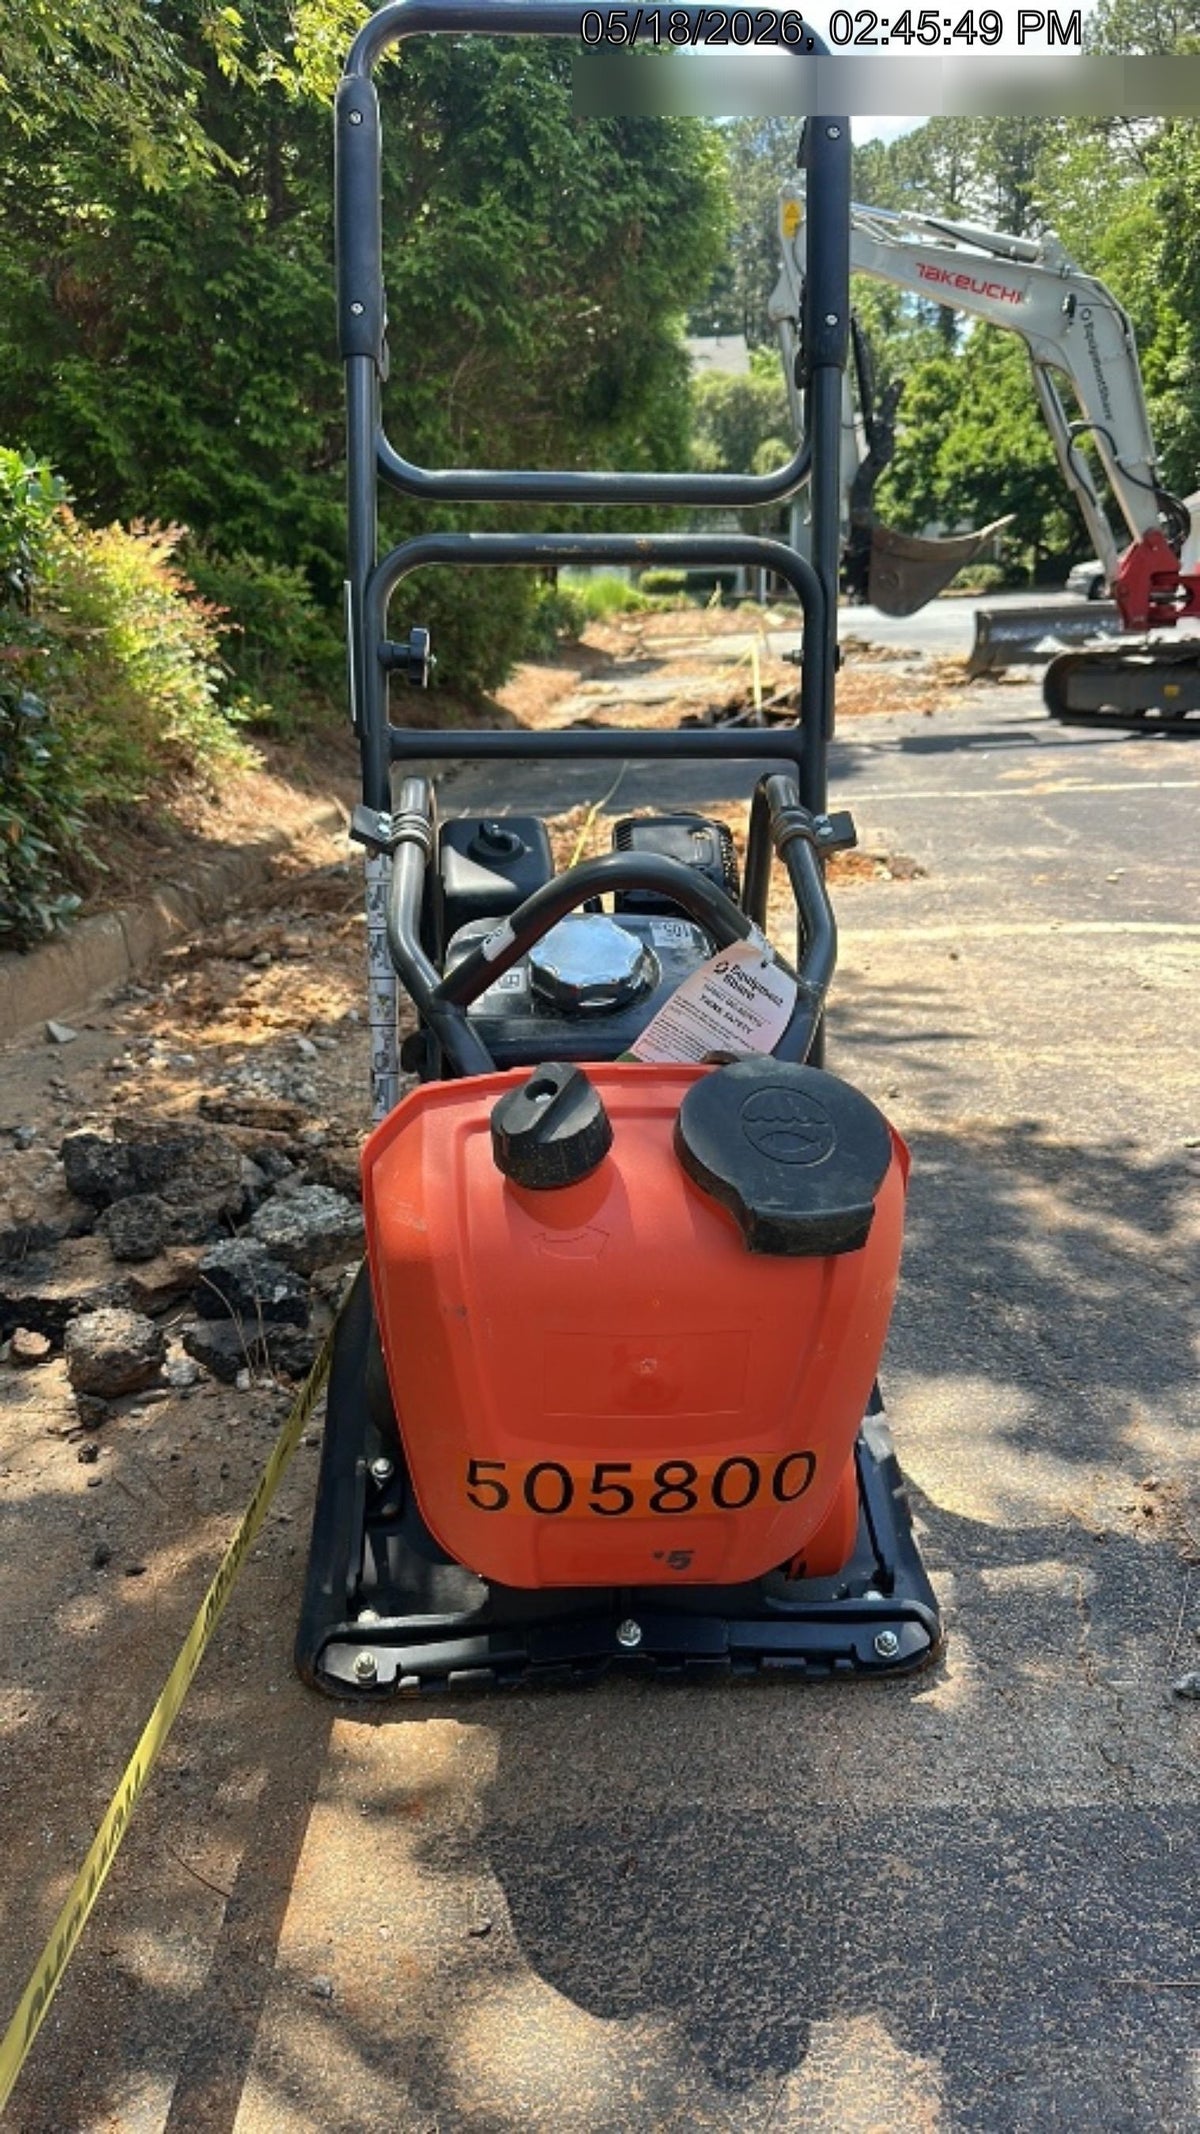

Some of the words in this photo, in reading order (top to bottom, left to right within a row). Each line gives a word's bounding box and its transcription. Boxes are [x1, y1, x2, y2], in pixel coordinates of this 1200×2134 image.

[723, 973, 755, 1002] Share
[730, 964, 784, 1008] Equipment
[465, 1450, 818, 1517] 505800
